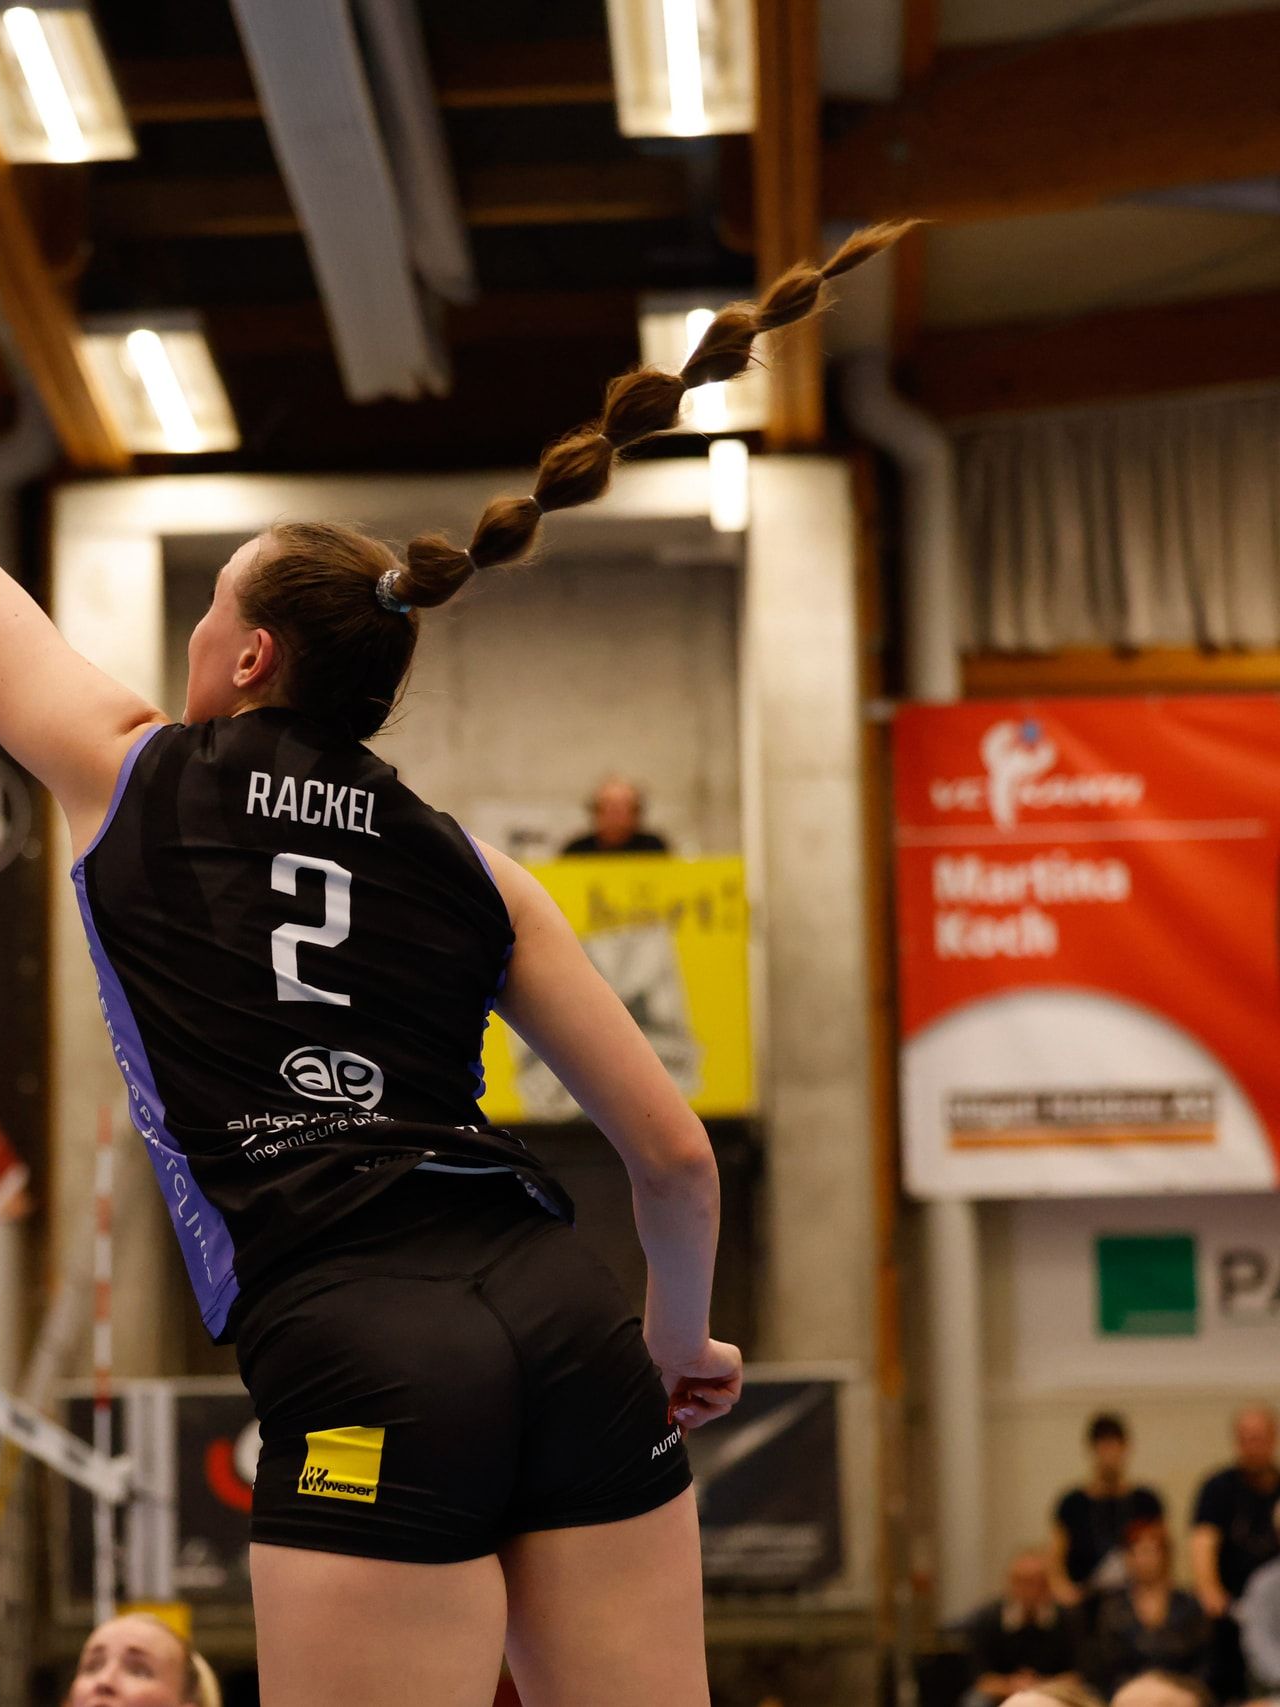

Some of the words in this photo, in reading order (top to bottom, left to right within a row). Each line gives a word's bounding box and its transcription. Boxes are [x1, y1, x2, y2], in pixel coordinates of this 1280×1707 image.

[246, 770, 381, 838] RACKEL
[933, 853, 1131, 904] Martina
[271, 852, 353, 1007] 2
[244, 1119, 339, 1164] Ingenieure
